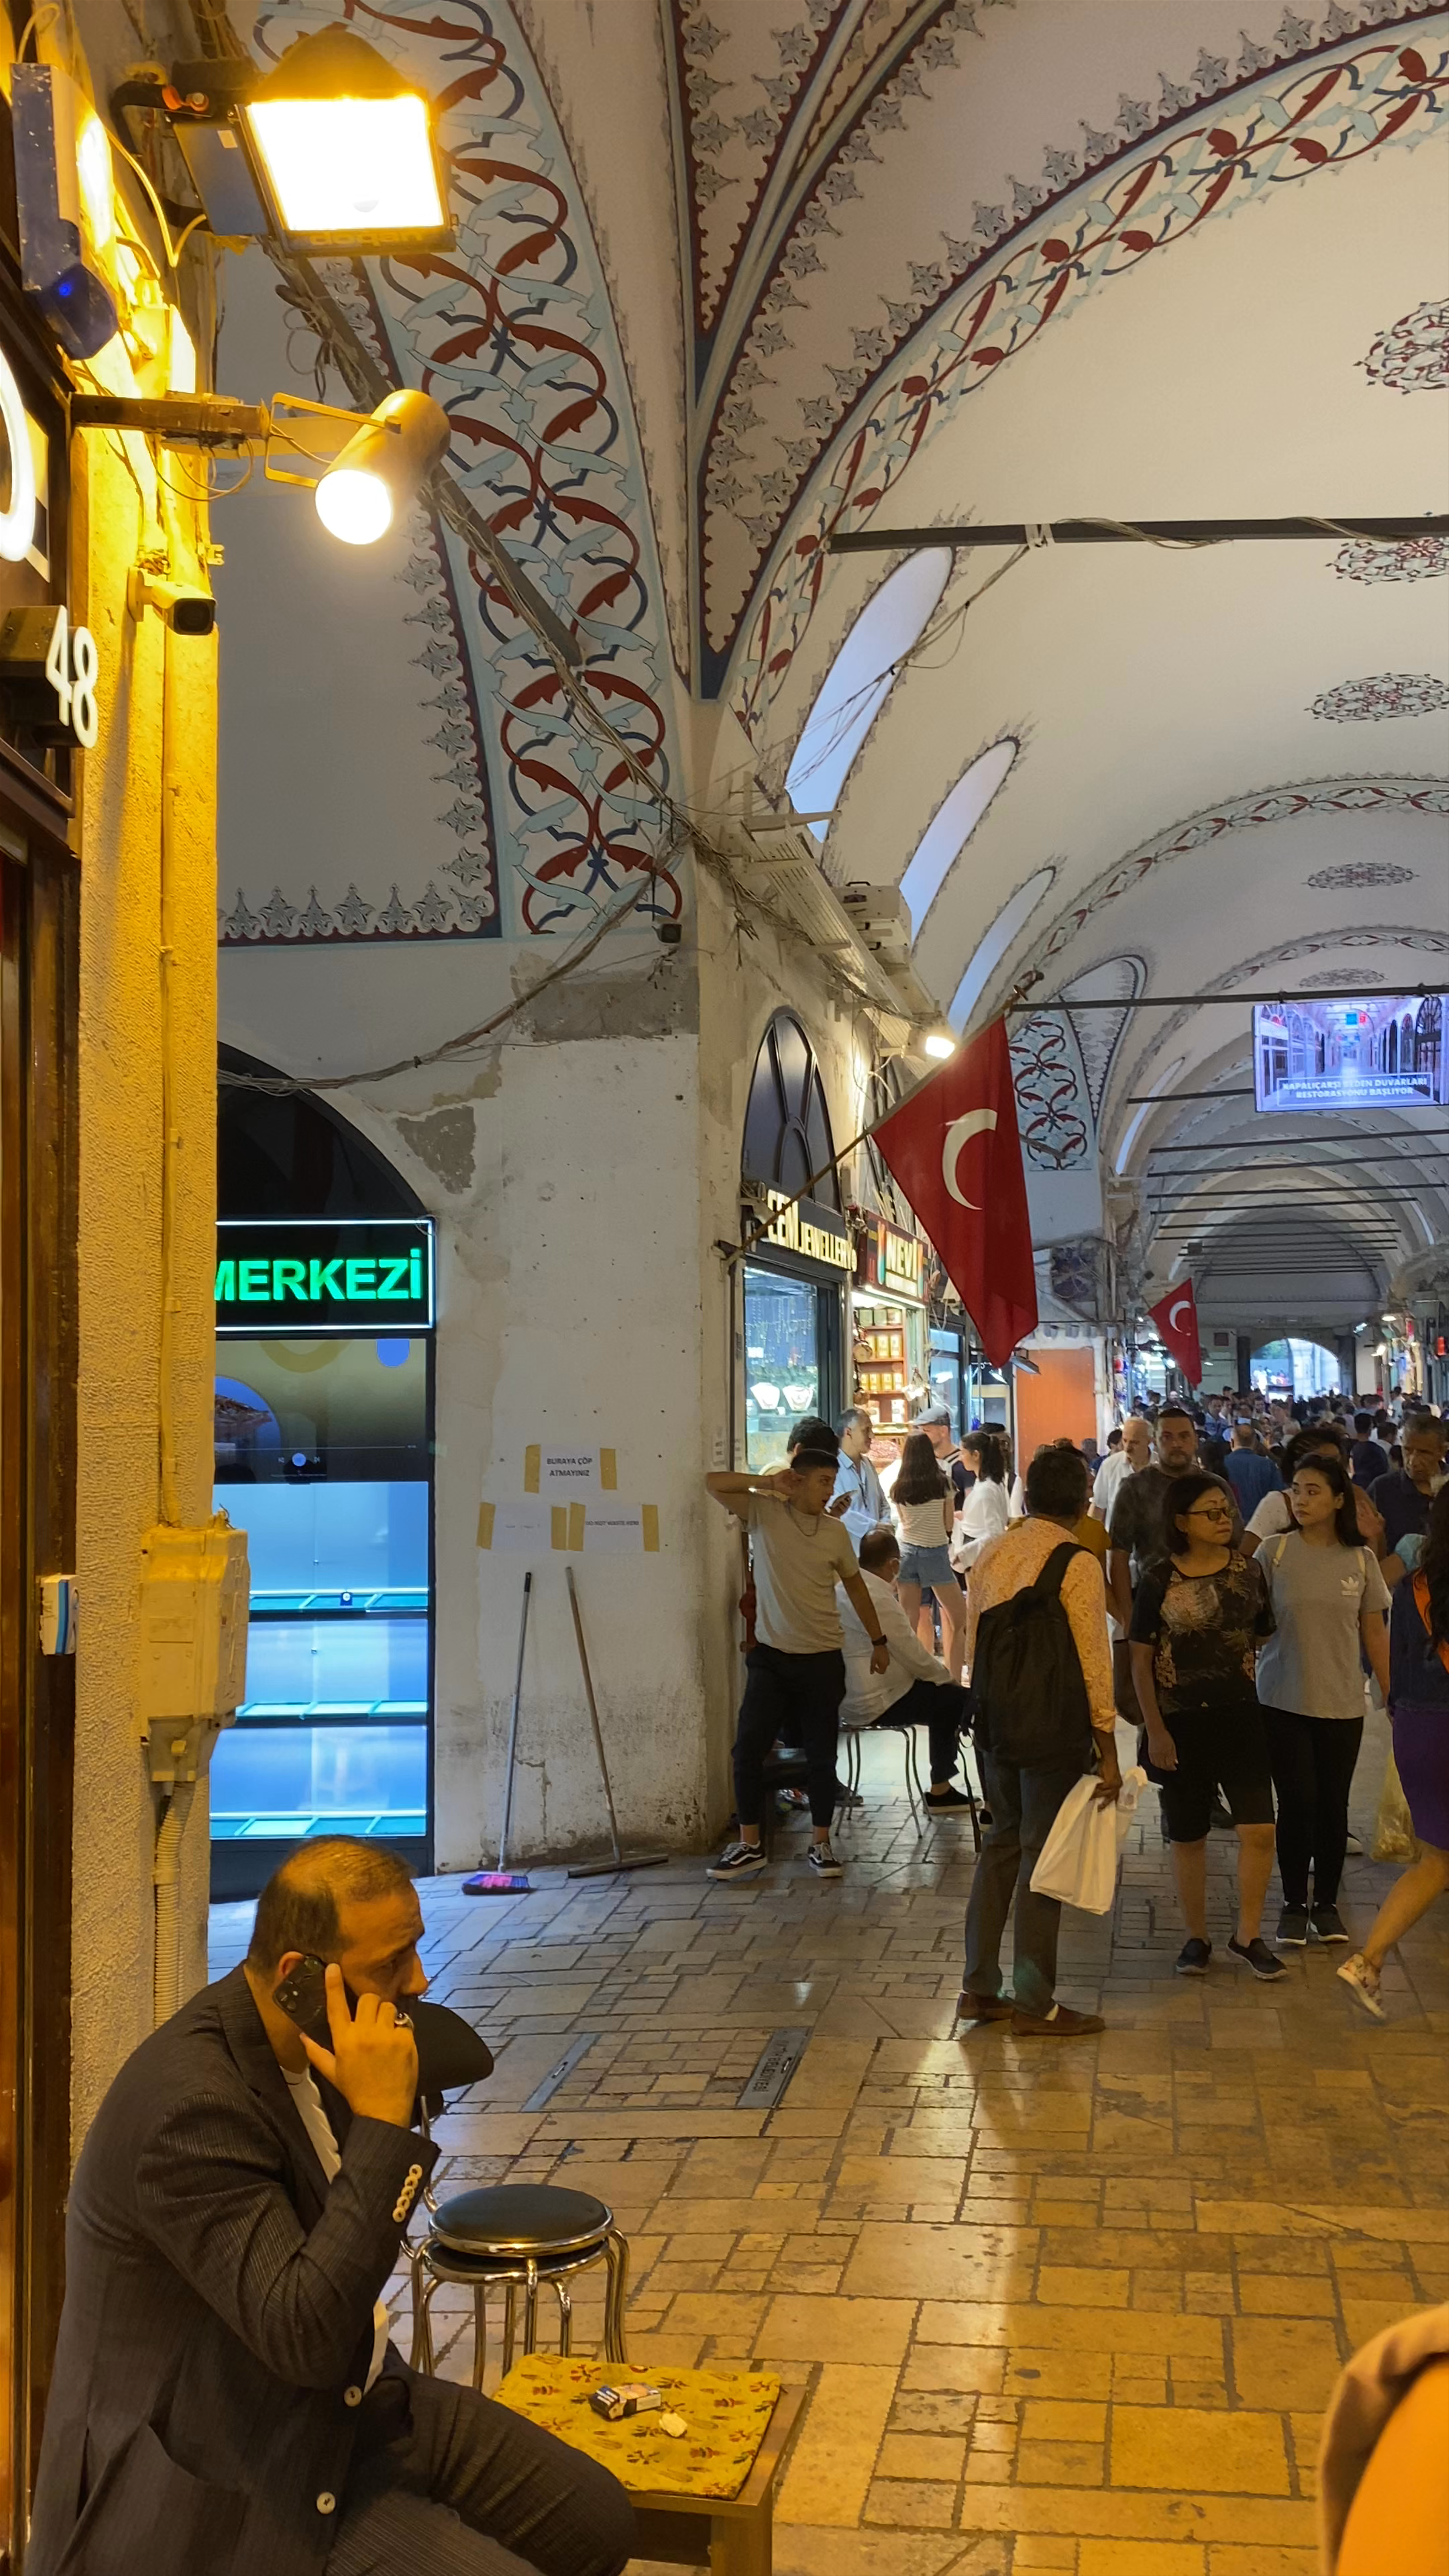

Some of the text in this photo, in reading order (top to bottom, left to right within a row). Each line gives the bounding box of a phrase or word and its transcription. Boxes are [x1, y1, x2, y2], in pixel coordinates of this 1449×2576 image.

[46, 605, 99, 749] 48
[1369, 1087, 1413, 1097] BAŞLIYOR
[1375, 1078, 1427, 1086] DUVARLARI
[797, 1221, 853, 1271] JEWELLERY
